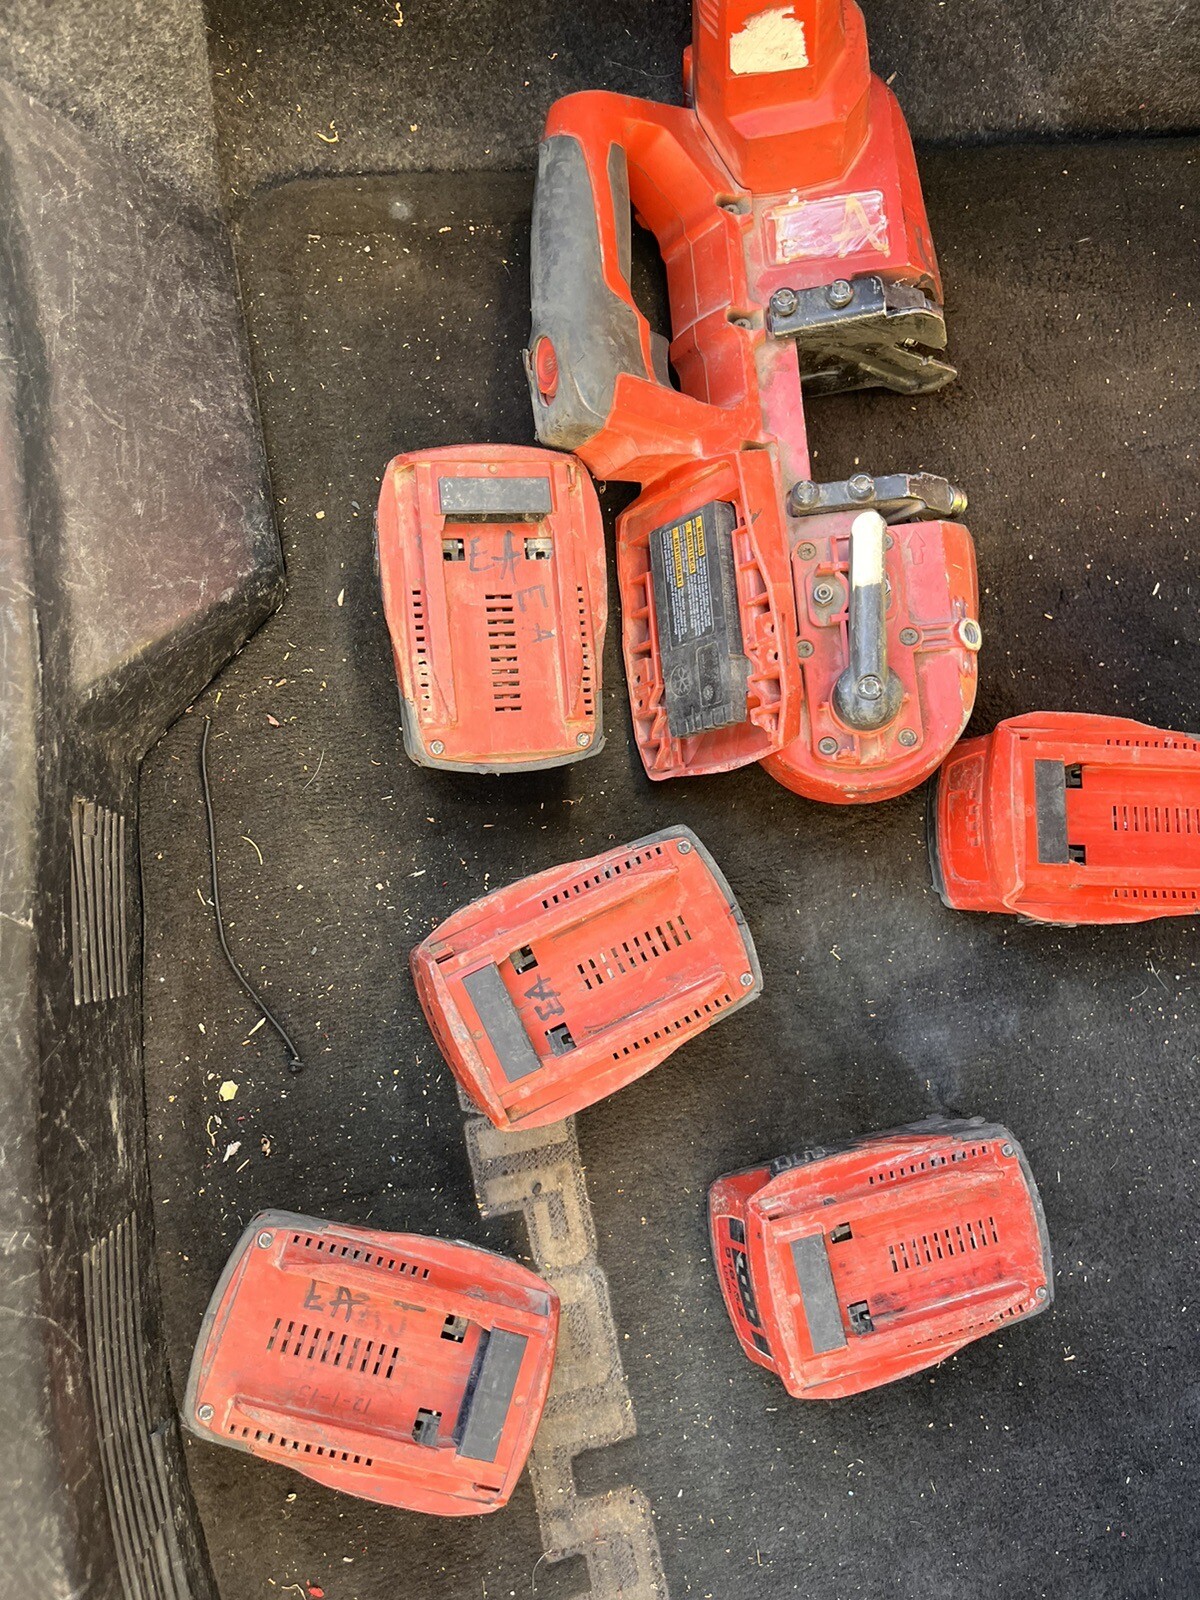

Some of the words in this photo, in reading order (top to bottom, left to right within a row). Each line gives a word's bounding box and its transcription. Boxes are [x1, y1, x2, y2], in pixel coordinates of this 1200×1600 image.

[468, 530, 522, 585] EA
[516, 584, 557, 643] EA
[523, 974, 565, 1022] EA
